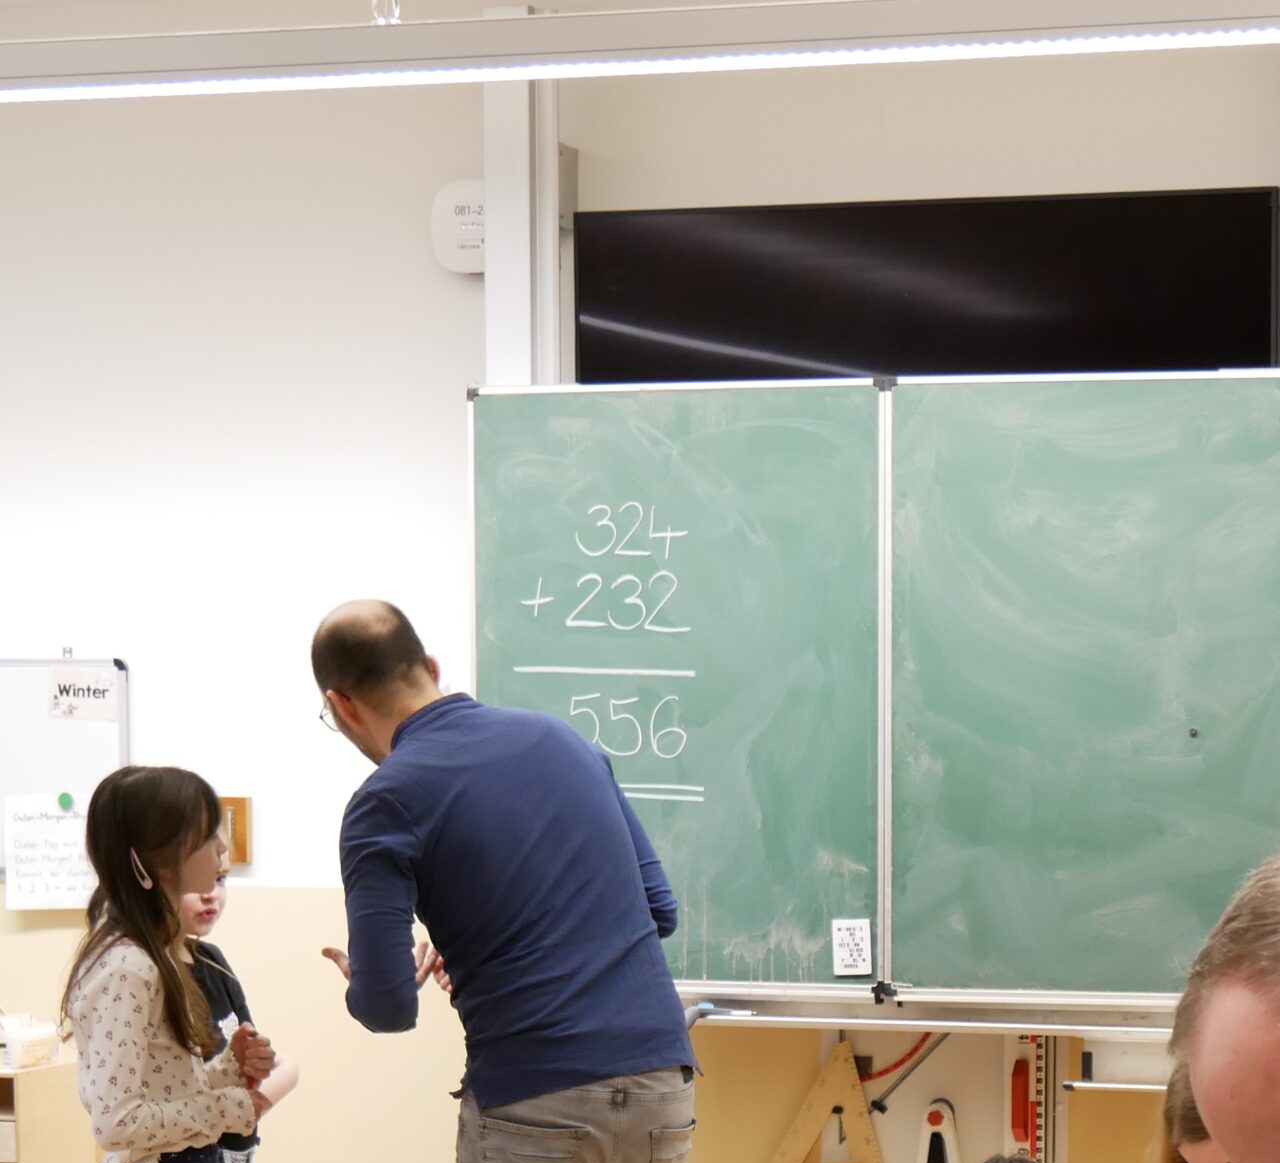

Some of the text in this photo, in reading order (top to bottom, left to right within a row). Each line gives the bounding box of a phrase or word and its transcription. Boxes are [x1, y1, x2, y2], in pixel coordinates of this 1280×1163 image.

[575, 501, 689, 560] 324
[520, 570, 692, 633] + 232
[57, 683, 109, 700] Winter
[569, 692, 688, 759] 556
